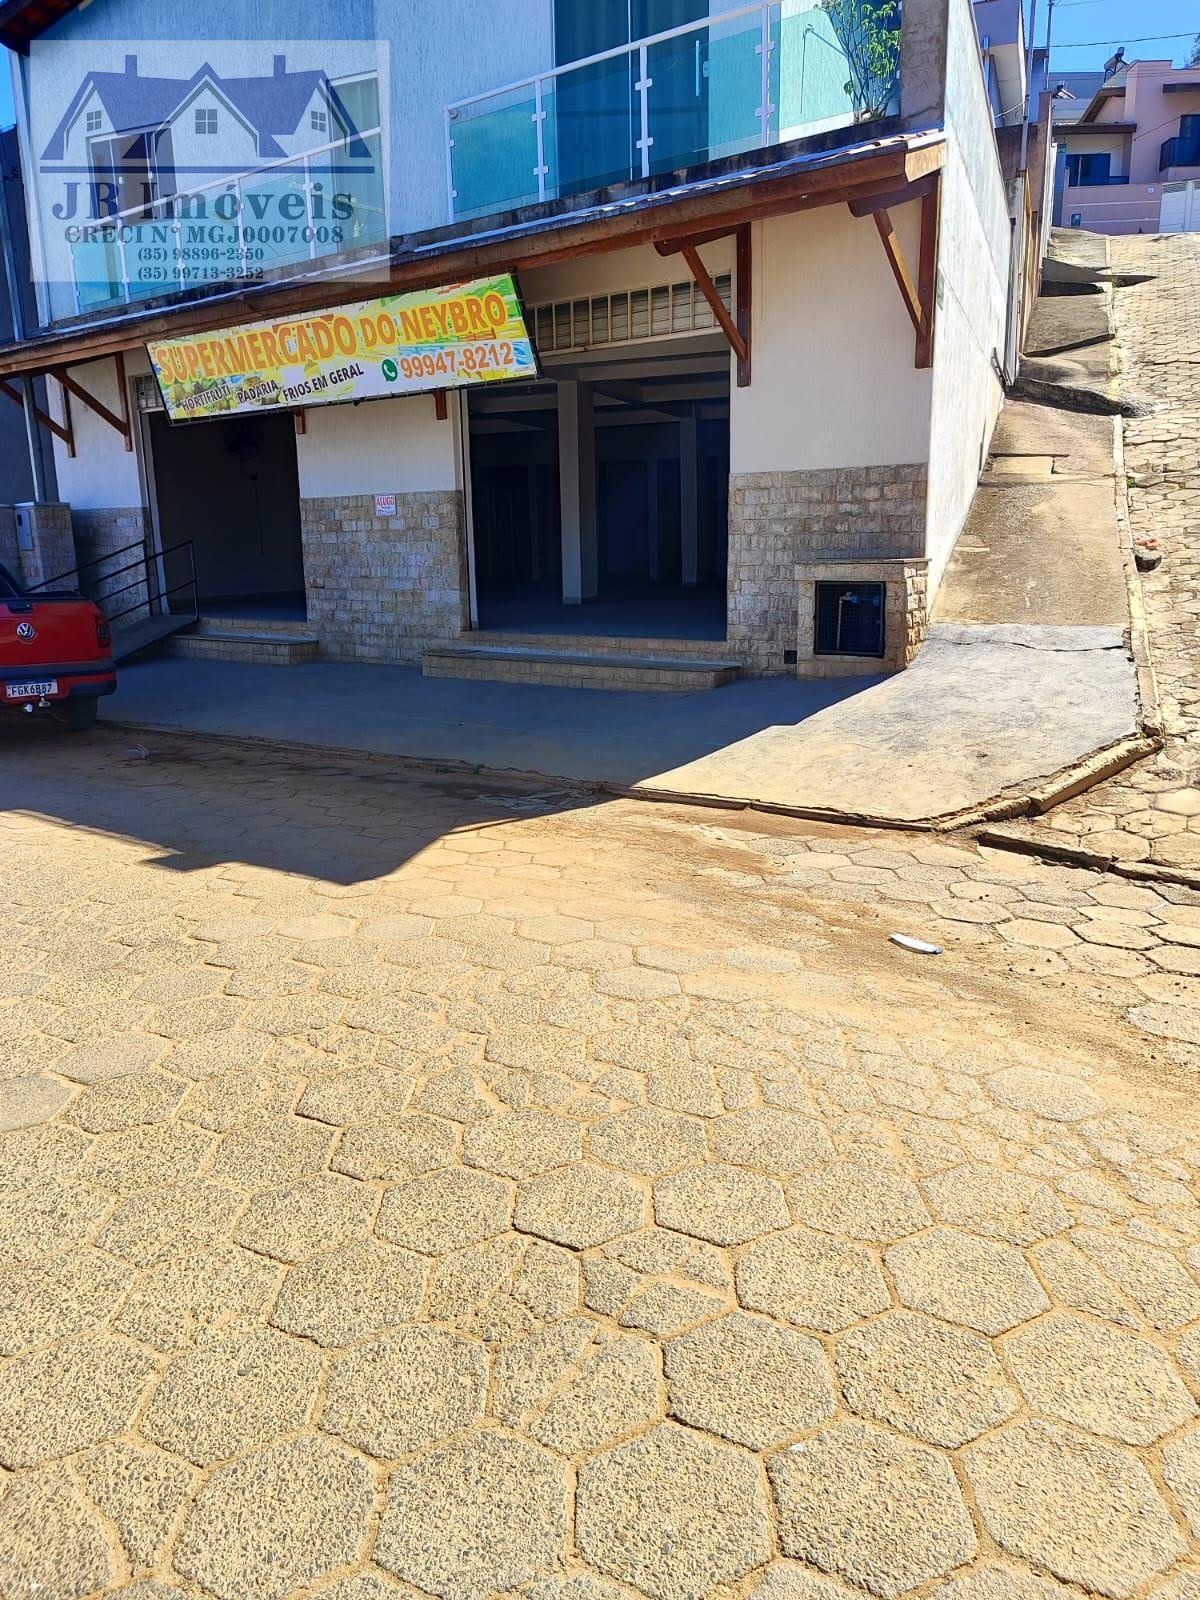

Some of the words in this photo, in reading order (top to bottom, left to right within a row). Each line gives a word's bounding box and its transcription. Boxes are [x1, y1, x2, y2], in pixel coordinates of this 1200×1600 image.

[156, 314, 358, 383] SUPERMERCADO
[359, 313, 396, 348] DO
[400, 293, 507, 342] NEYBRO
[400, 341, 515, 379] 99947-8212
[181, 384, 232, 411] HORTIFRUTI
[282, 380, 312, 401] FRIOS
[312, 374, 328, 392] EM
[329, 362, 365, 385] GERAL
[376, 496, 395, 506] ALUGO
